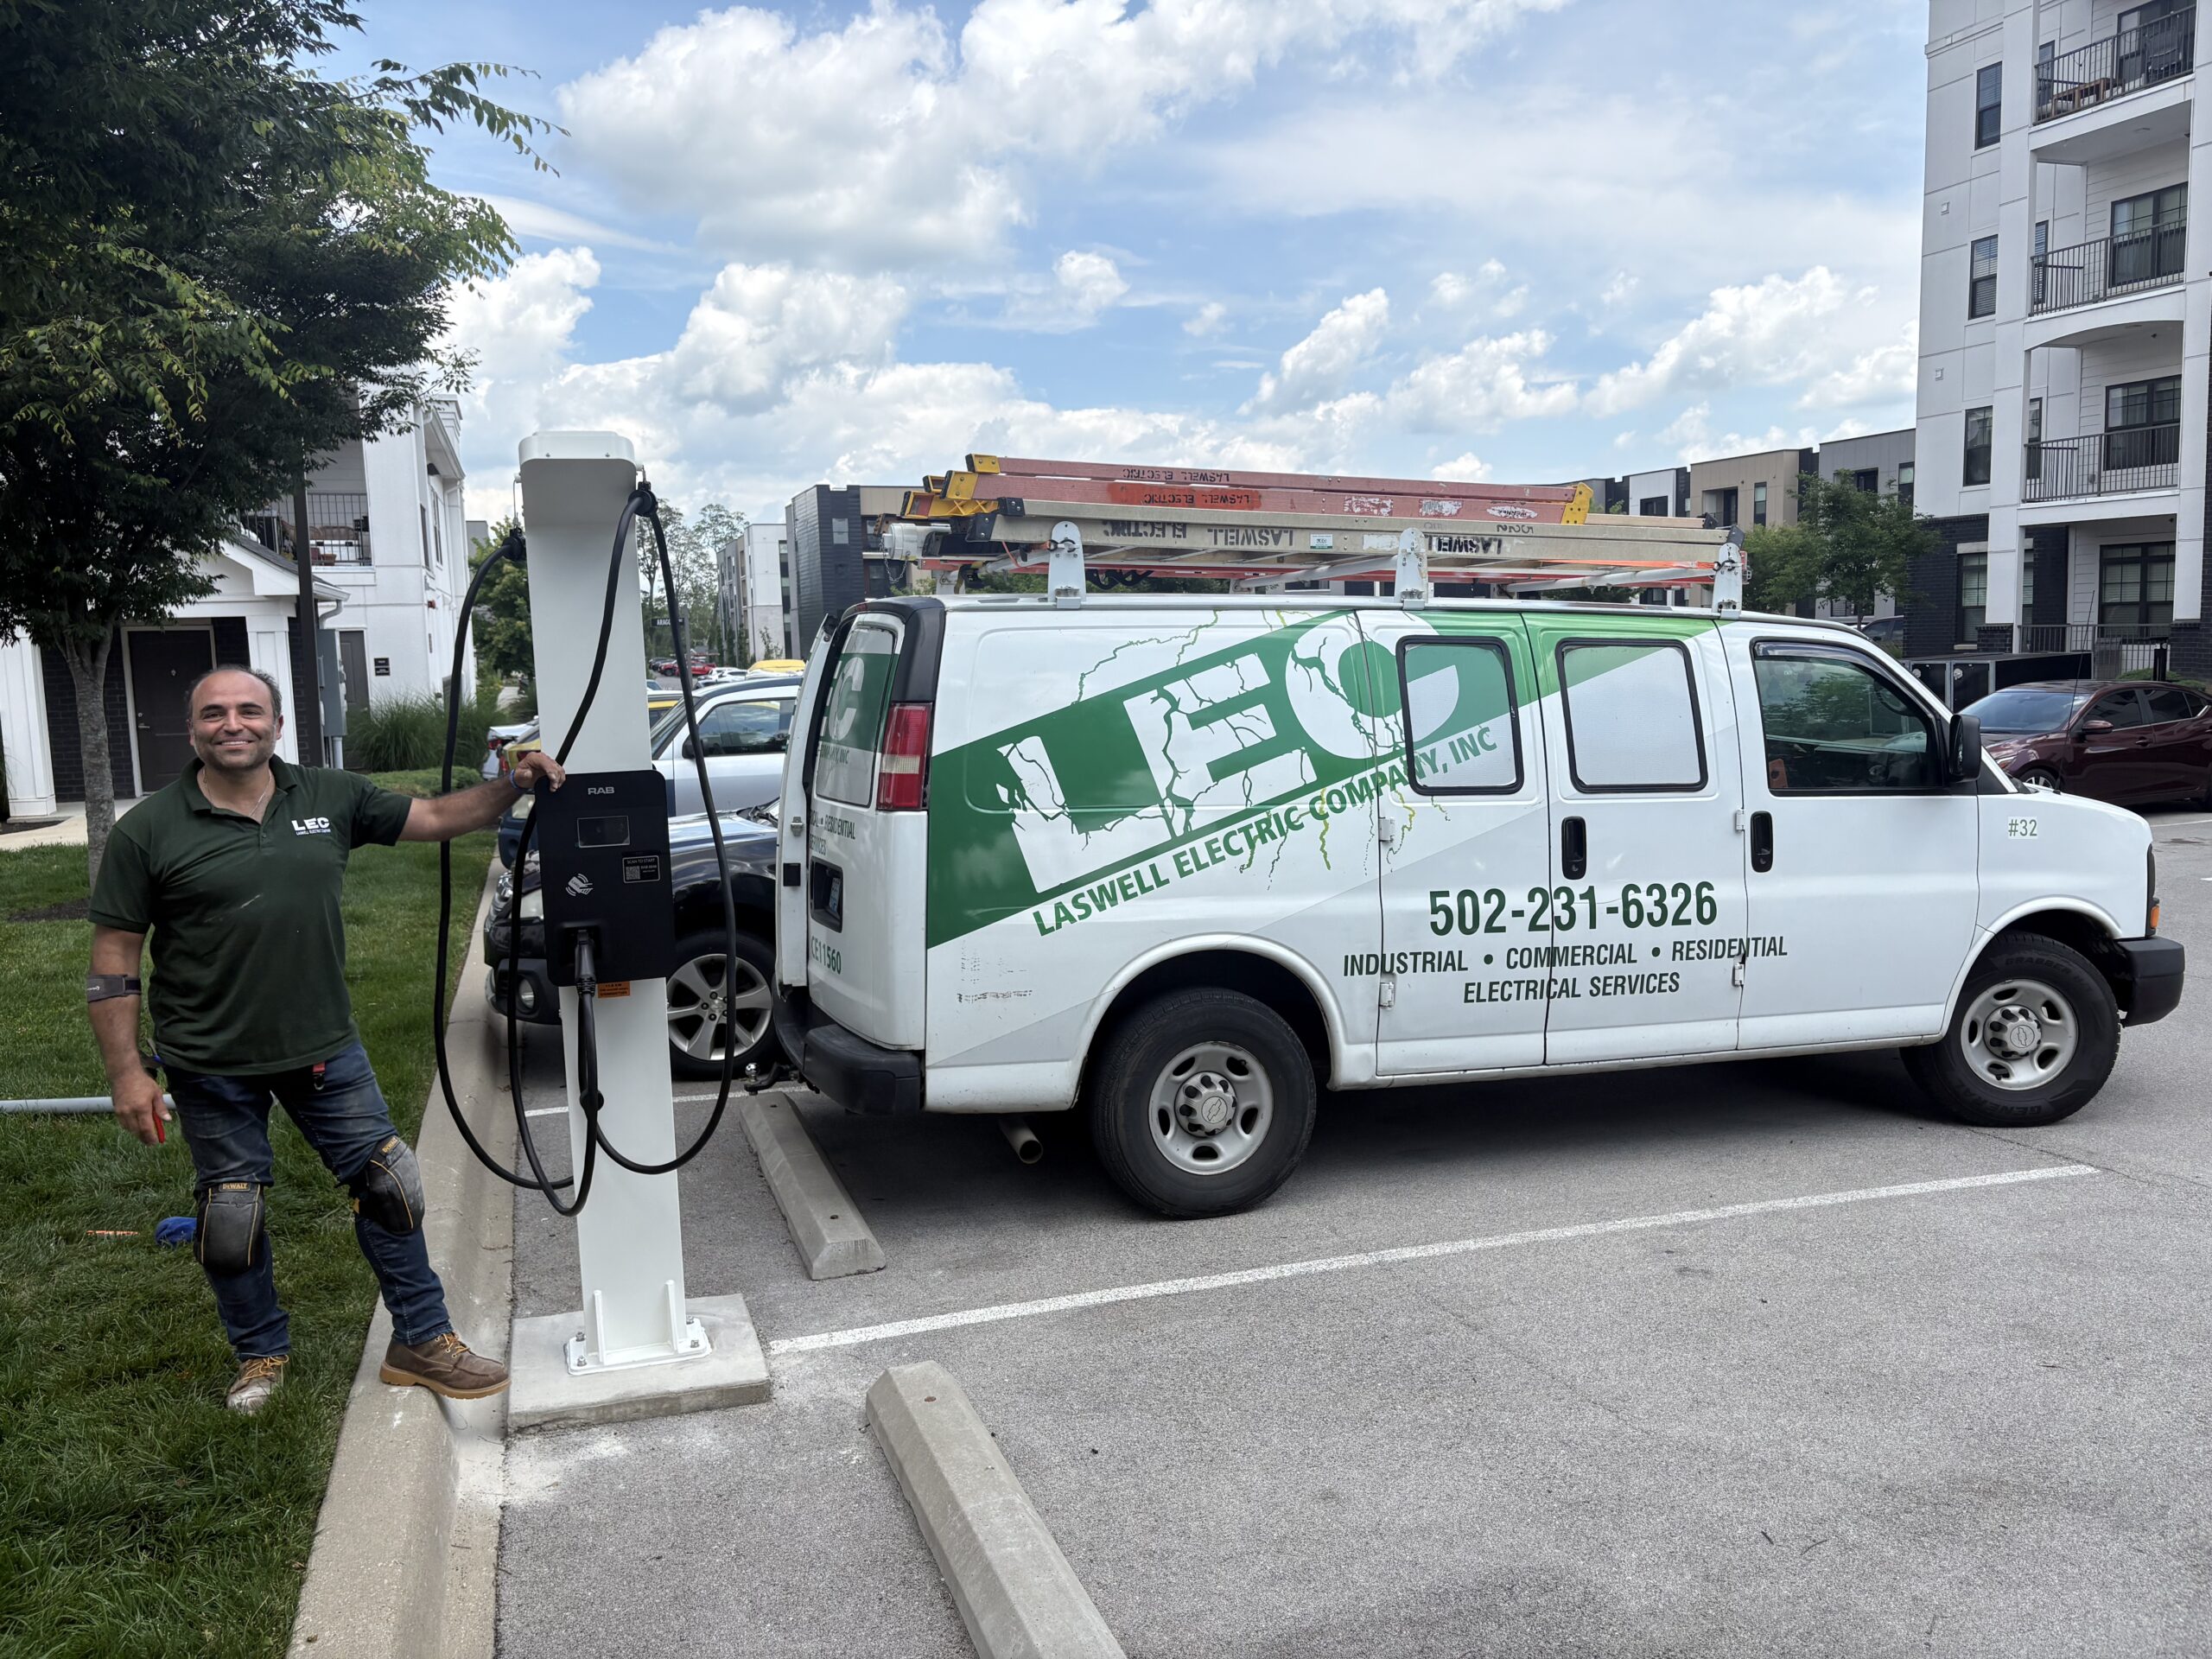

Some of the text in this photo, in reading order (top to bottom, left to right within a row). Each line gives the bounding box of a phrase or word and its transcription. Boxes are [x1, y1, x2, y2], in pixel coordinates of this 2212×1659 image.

[1123, 468, 1230, 482] LASWELL ELECTRIC
[1144, 493, 1251, 504] LASWELL ELECTRIC
[1207, 527, 1294, 546] LASWELL
[996, 610, 1459, 893] LEC
[588, 786, 615, 795] RAB
[291, 817, 330, 831] LEC
[824, 814, 856, 840] RESIDENTIAL
[1033, 725, 1497, 937] LASWELL ELECTRIC COMPANY, INC
[2008, 819, 2037, 837] #32
[1429, 881, 1718, 936] 502-231-6326
[1343, 936, 1788, 976] INDUSTRIAL COMMERCIAL RESIDENTIAL
[1463, 972, 1681, 1003] ELECTRICAL SERVICES
